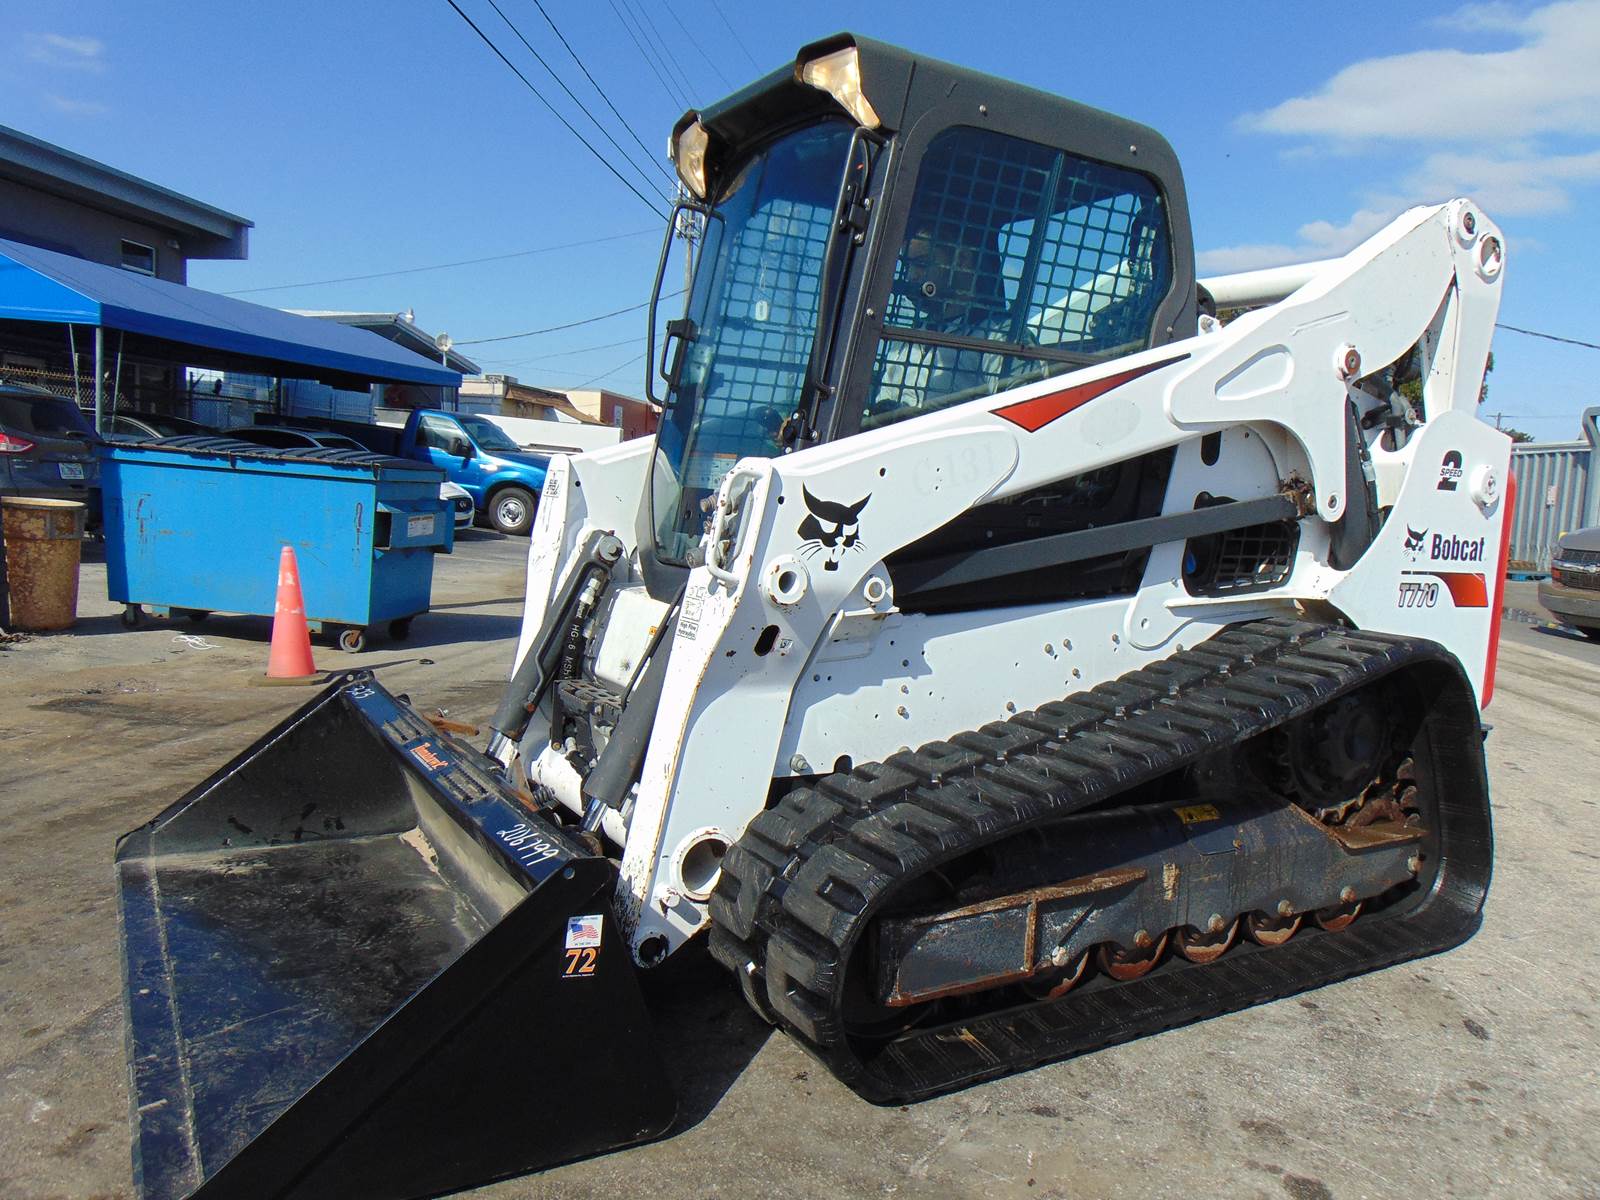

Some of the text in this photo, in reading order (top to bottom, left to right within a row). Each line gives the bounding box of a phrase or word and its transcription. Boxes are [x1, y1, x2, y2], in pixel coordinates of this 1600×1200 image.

[1437, 450, 1463, 491] 2
[1440, 467, 1463, 478] SPEED
[1430, 534, 1485, 562] Bobcat
[1398, 583, 1439, 607] T770
[496, 823, 559, 867] 206799
[565, 948, 597, 975] 72
